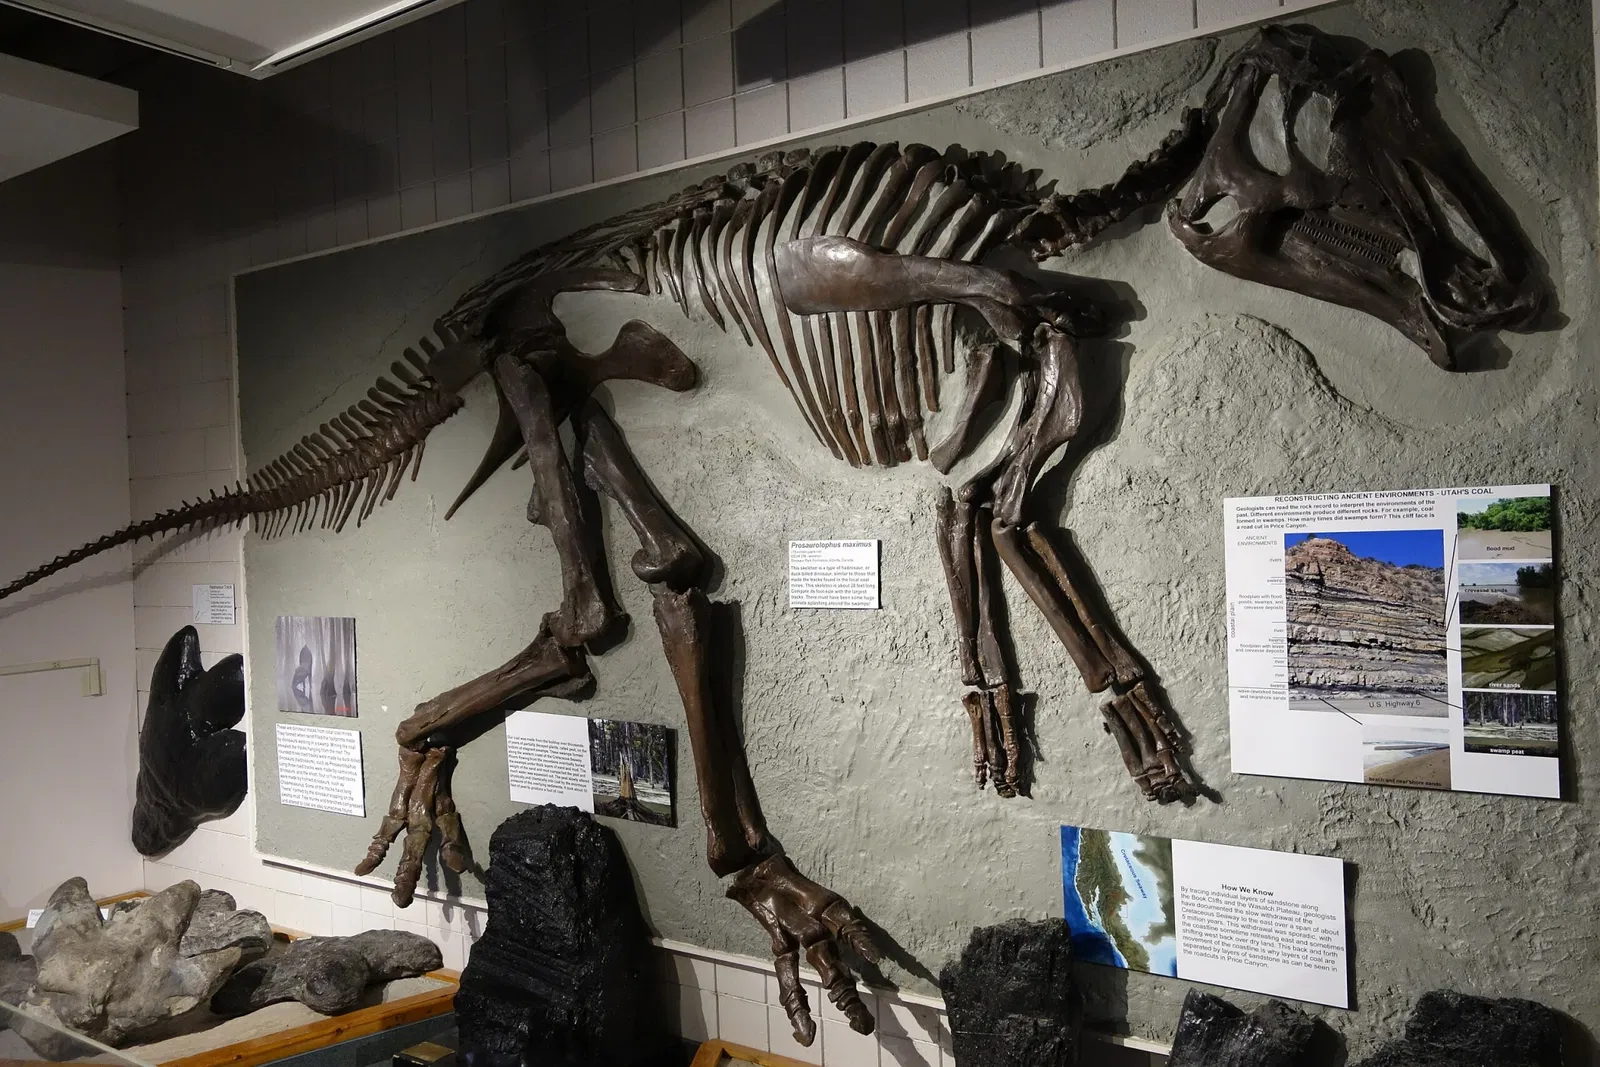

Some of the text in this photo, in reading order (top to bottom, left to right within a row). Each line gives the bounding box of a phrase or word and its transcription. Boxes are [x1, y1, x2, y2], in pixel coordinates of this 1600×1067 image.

[1120, 849, 1147, 899] Cretaceous Seaway
[1189, 887, 1209, 896] tracing
[1210, 890, 1238, 899] individual
[1240, 894, 1258, 903] layers
[1267, 897, 1299, 907] sandstone
[1300, 902, 1319, 911] along
[1252, 888, 1274, 897] Know
[1182, 907, 1214, 917] Cretaceous
[1215, 912, 1239, 922] Seaway
[1196, 902, 1232, 912] documented
[1260, 911, 1293, 921] withdrawal
[1248, 902, 1274, 911] Wasatch
[1276, 906, 1302, 916] Plateau,
[1303, 910, 1336, 921] geologists
[1192, 922, 1218, 931] coastline
[1219, 926, 1248, 936] sometime
[1250, 931, 1279, 942] retreating
[1309, 940, 1344, 950] sometimes
[1207, 919, 1226, 927] years.
[1240, 923, 1272, 932] withdrawal
[1288, 930, 1317, 940] sporadic,
